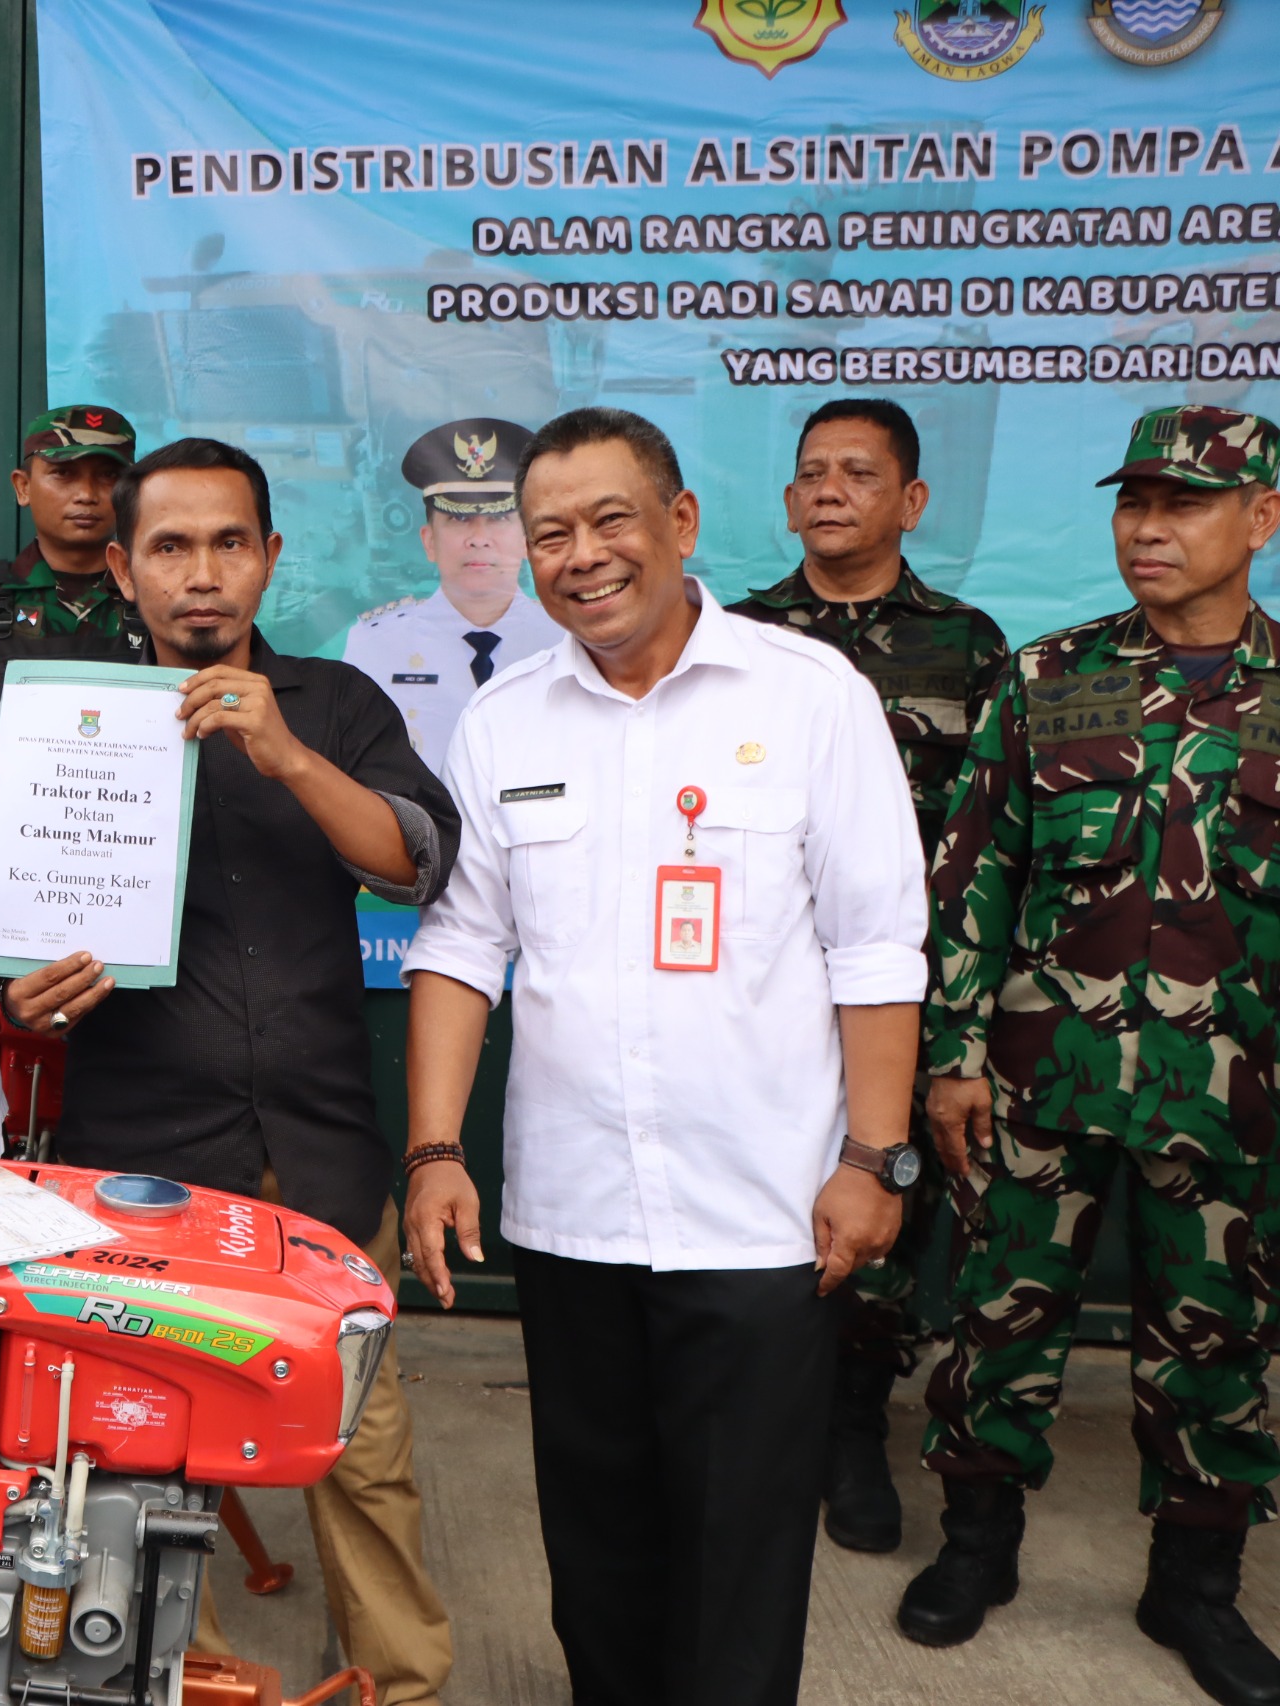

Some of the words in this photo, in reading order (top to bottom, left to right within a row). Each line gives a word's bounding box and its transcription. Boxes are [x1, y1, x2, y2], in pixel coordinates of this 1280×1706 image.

[1093, 18, 1116, 50] SATYA
[1115, 46, 1145, 62] KARYA
[1146, 47, 1180, 63] KERTA
[1180, 12, 1219, 52] RAHARJA
[913, 47, 956, 77] IMAN
[965, 45, 1025, 78] TAQWA
[132, 138, 668, 199] PENDISTRIBUSIAN
[684, 131, 997, 187] ALSINTAN
[1020, 124, 1251, 181] POMPA
[473, 215, 632, 256] DALAM
[640, 211, 830, 253] RANGKA
[839, 206, 1171, 250] PENINGKATAN
[1179, 203, 1280, 245] ARE
[428, 281, 659, 323] PRODUKSI
[667, 280, 777, 319] PADI
[786, 278, 952, 317] SAWAH
[962, 277, 1014, 315] DI
[1022, 271, 1280, 316] KABUPATE
[722, 348, 836, 386] YANG
[840, 346, 1089, 384] BERSUMBER
[1089, 344, 1192, 383] DARI
[38, 737, 76, 746] PERTANIAN
[93, 741, 137, 750] KETAHANAN
[139, 744, 168, 752] PANGAN
[47, 746, 89, 755] KABUPATEN
[90, 750, 134, 759] TANGERANG
[56, 763, 116, 781] Bantuan
[30, 782, 92, 801] Traktor
[97, 786, 138, 804] Roda
[143, 790, 152, 804] 2
[64, 806, 114, 823] Poktan
[20, 823, 82, 845] Cakung
[86, 830, 156, 846] Makmur
[61, 846, 113, 859] Kandawati
[8, 867, 41, 883] Kec.
[46, 870, 105, 890] Gunung
[110, 873, 151, 890] Kaler
[33, 889, 82, 905] APBN
[86, 892, 123, 908] 2024
[68, 912, 85, 926] 01
[219, 1203, 256, 1258] Kubota
[92, 1250, 170, 1272] 2024
[23, 1264, 101, 1283] SUPER
[106, 1274, 193, 1297] POWER
[23, 1275, 58, 1287] DIRECT
[59, 1280, 110, 1293] INJECTION
[76, 1295, 154, 1337] RD
[113, 1385, 153, 1394] PERHATIAN
